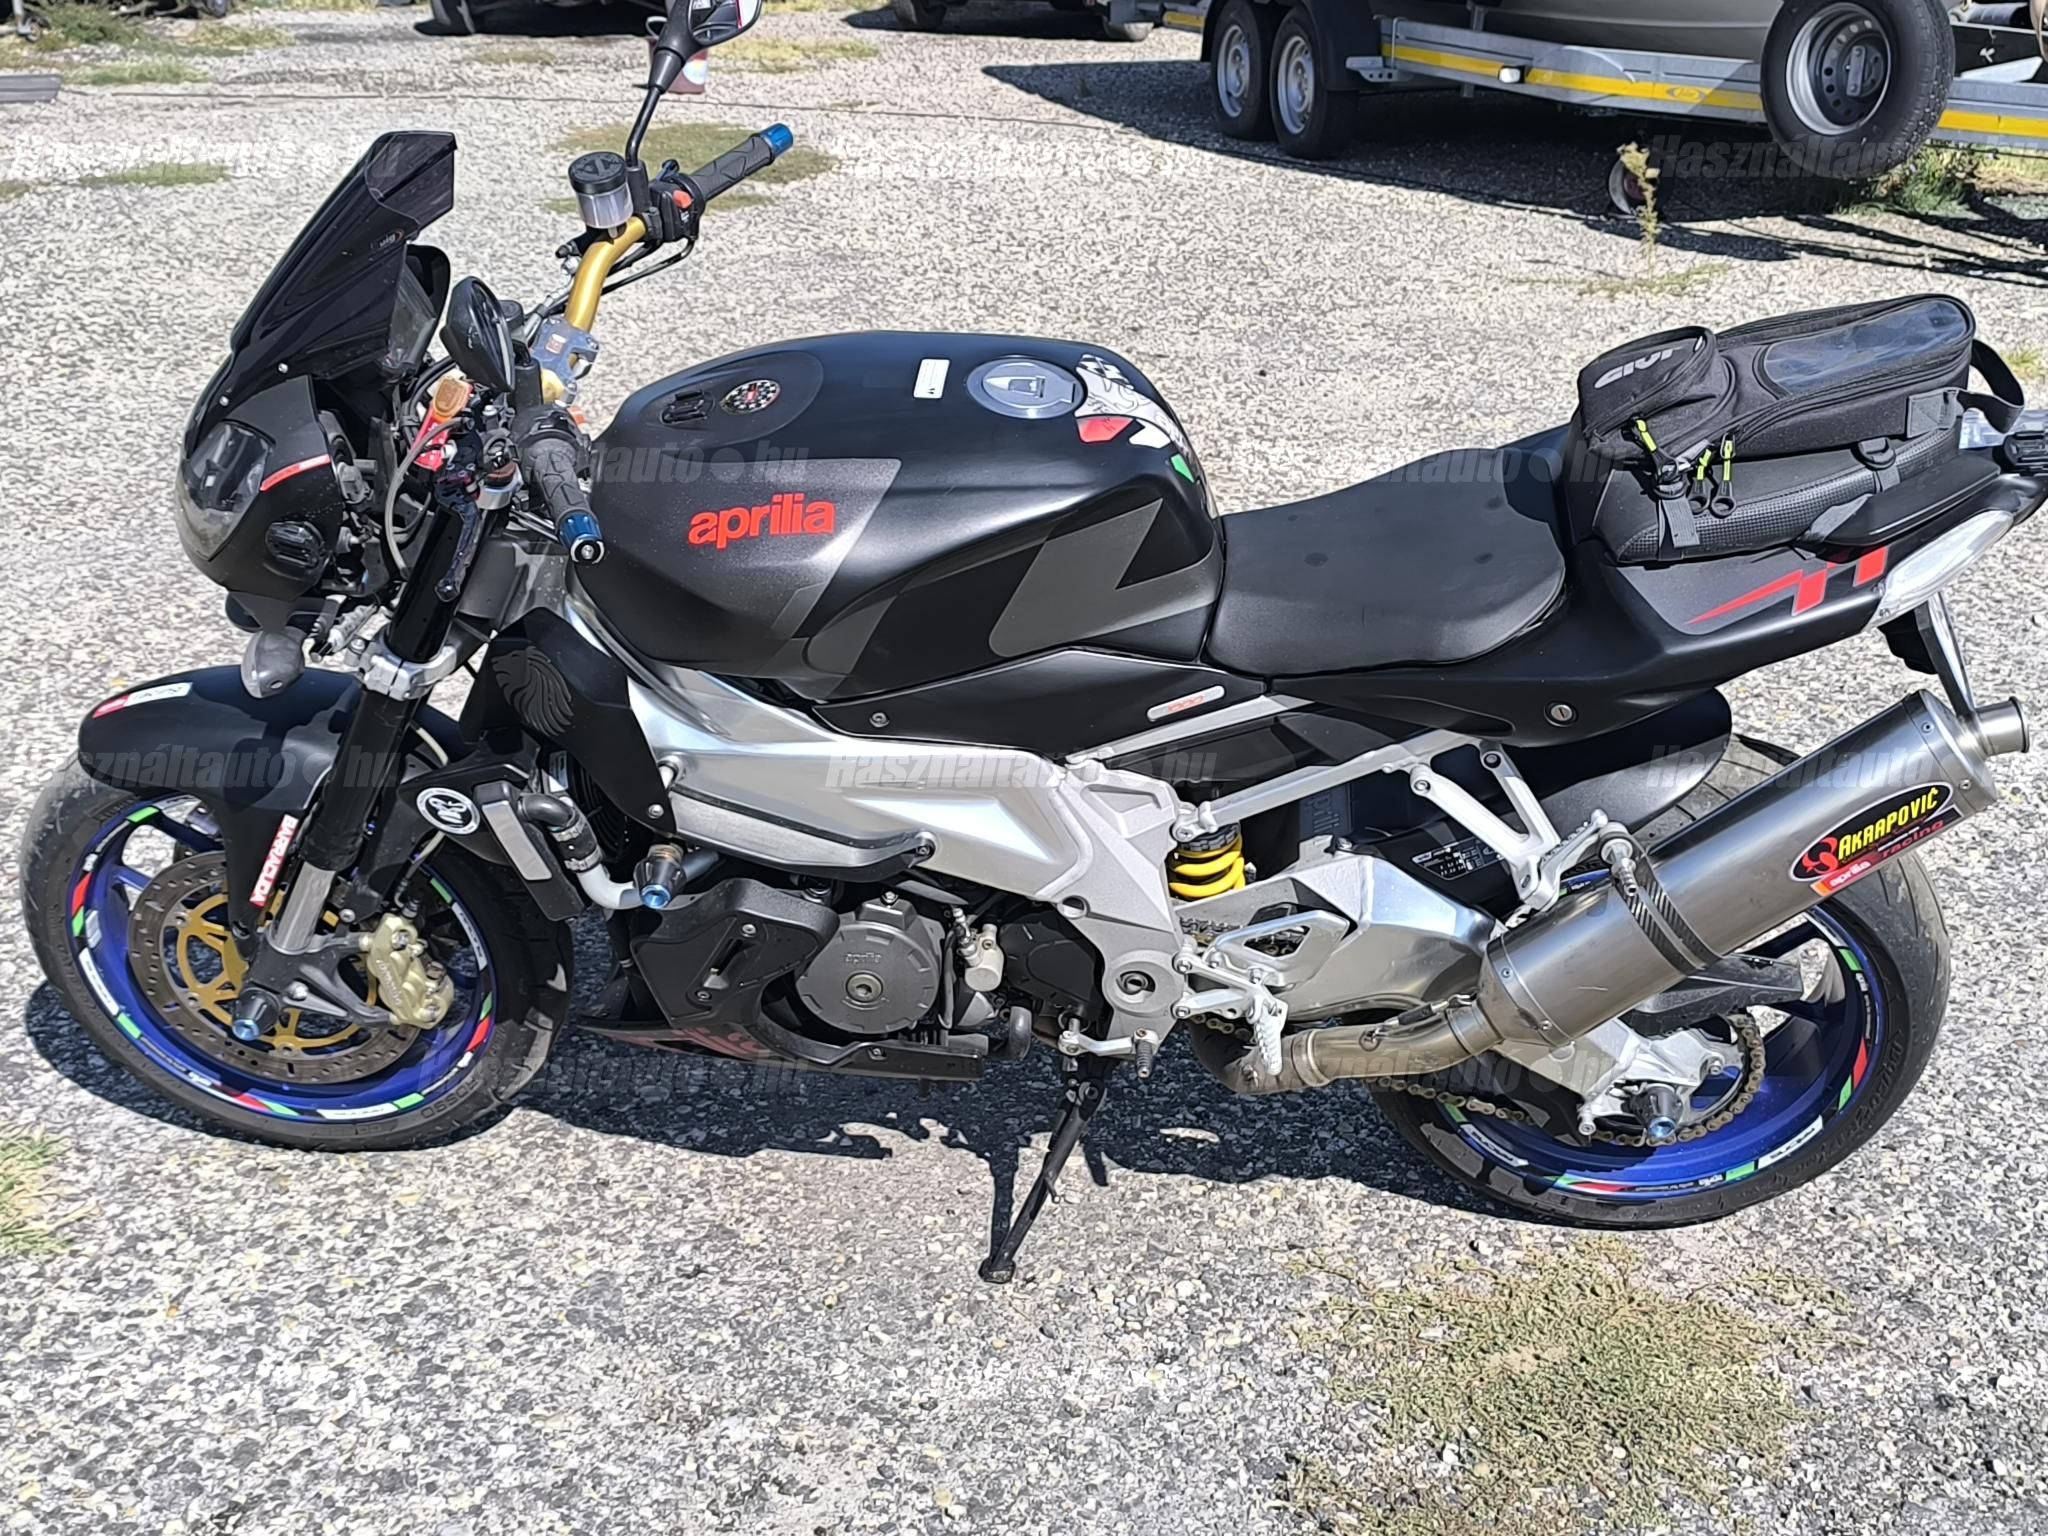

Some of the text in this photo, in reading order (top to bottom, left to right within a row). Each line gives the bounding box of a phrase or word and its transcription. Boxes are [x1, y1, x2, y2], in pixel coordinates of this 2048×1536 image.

[687, 491, 837, 550] aprilia
[1306, 793, 1341, 834] prili
[249, 814, 300, 905] BARRACUDA
